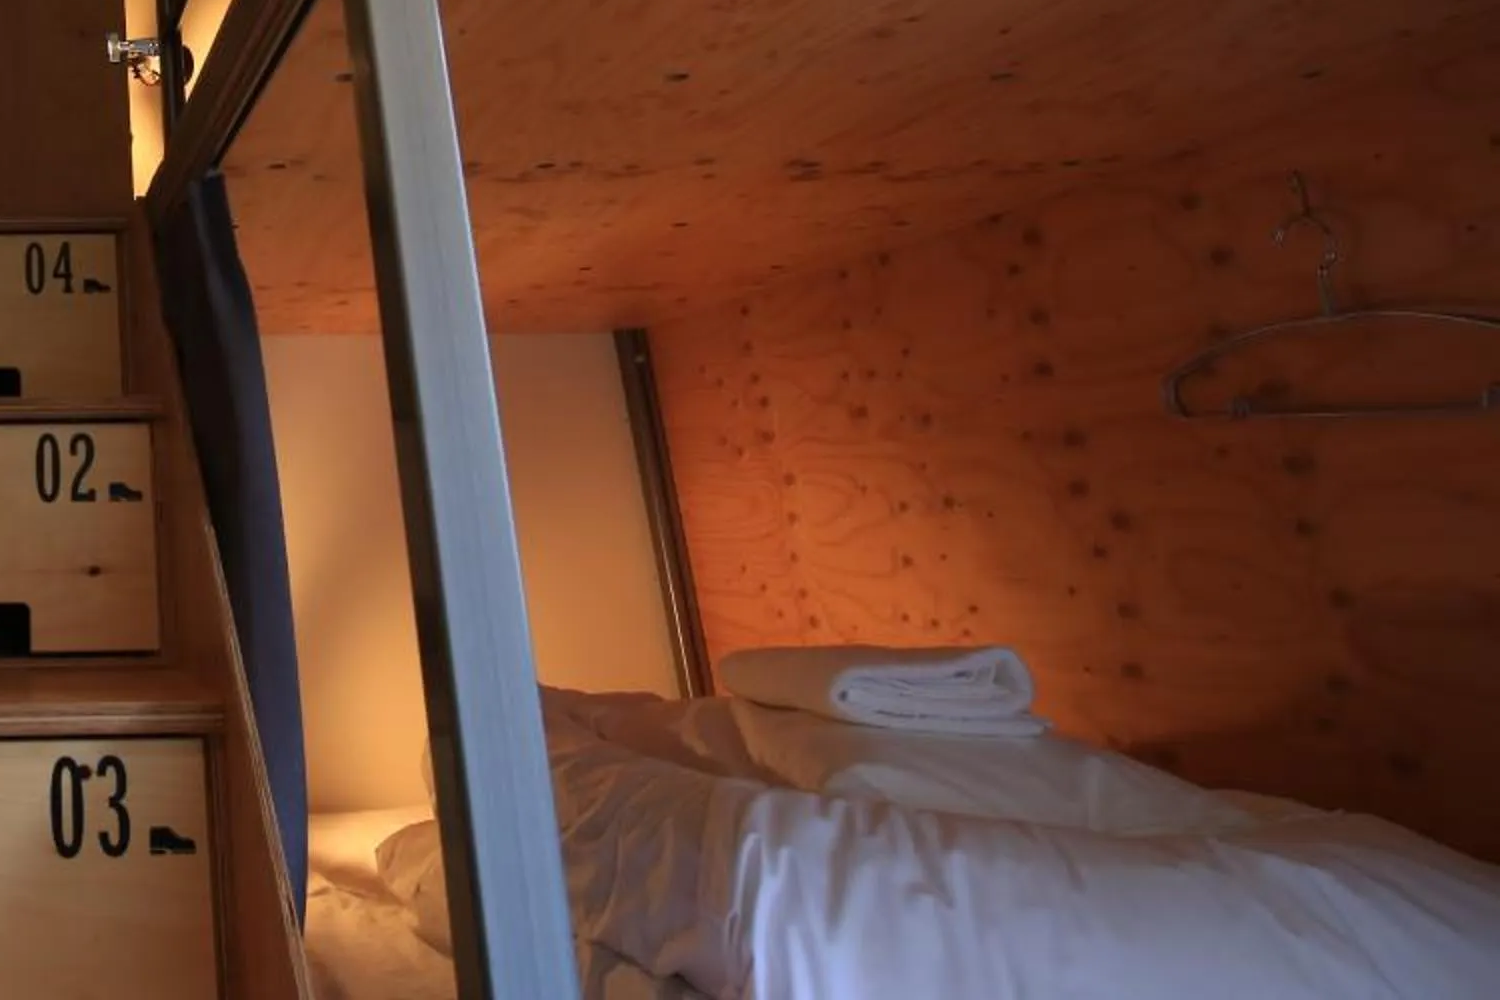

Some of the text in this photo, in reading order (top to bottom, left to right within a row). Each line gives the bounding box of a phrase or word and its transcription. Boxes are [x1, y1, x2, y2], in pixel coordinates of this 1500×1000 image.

[24, 241, 75, 295] 04
[35, 432, 97, 504] 02
[50, 755, 131, 860] 03
